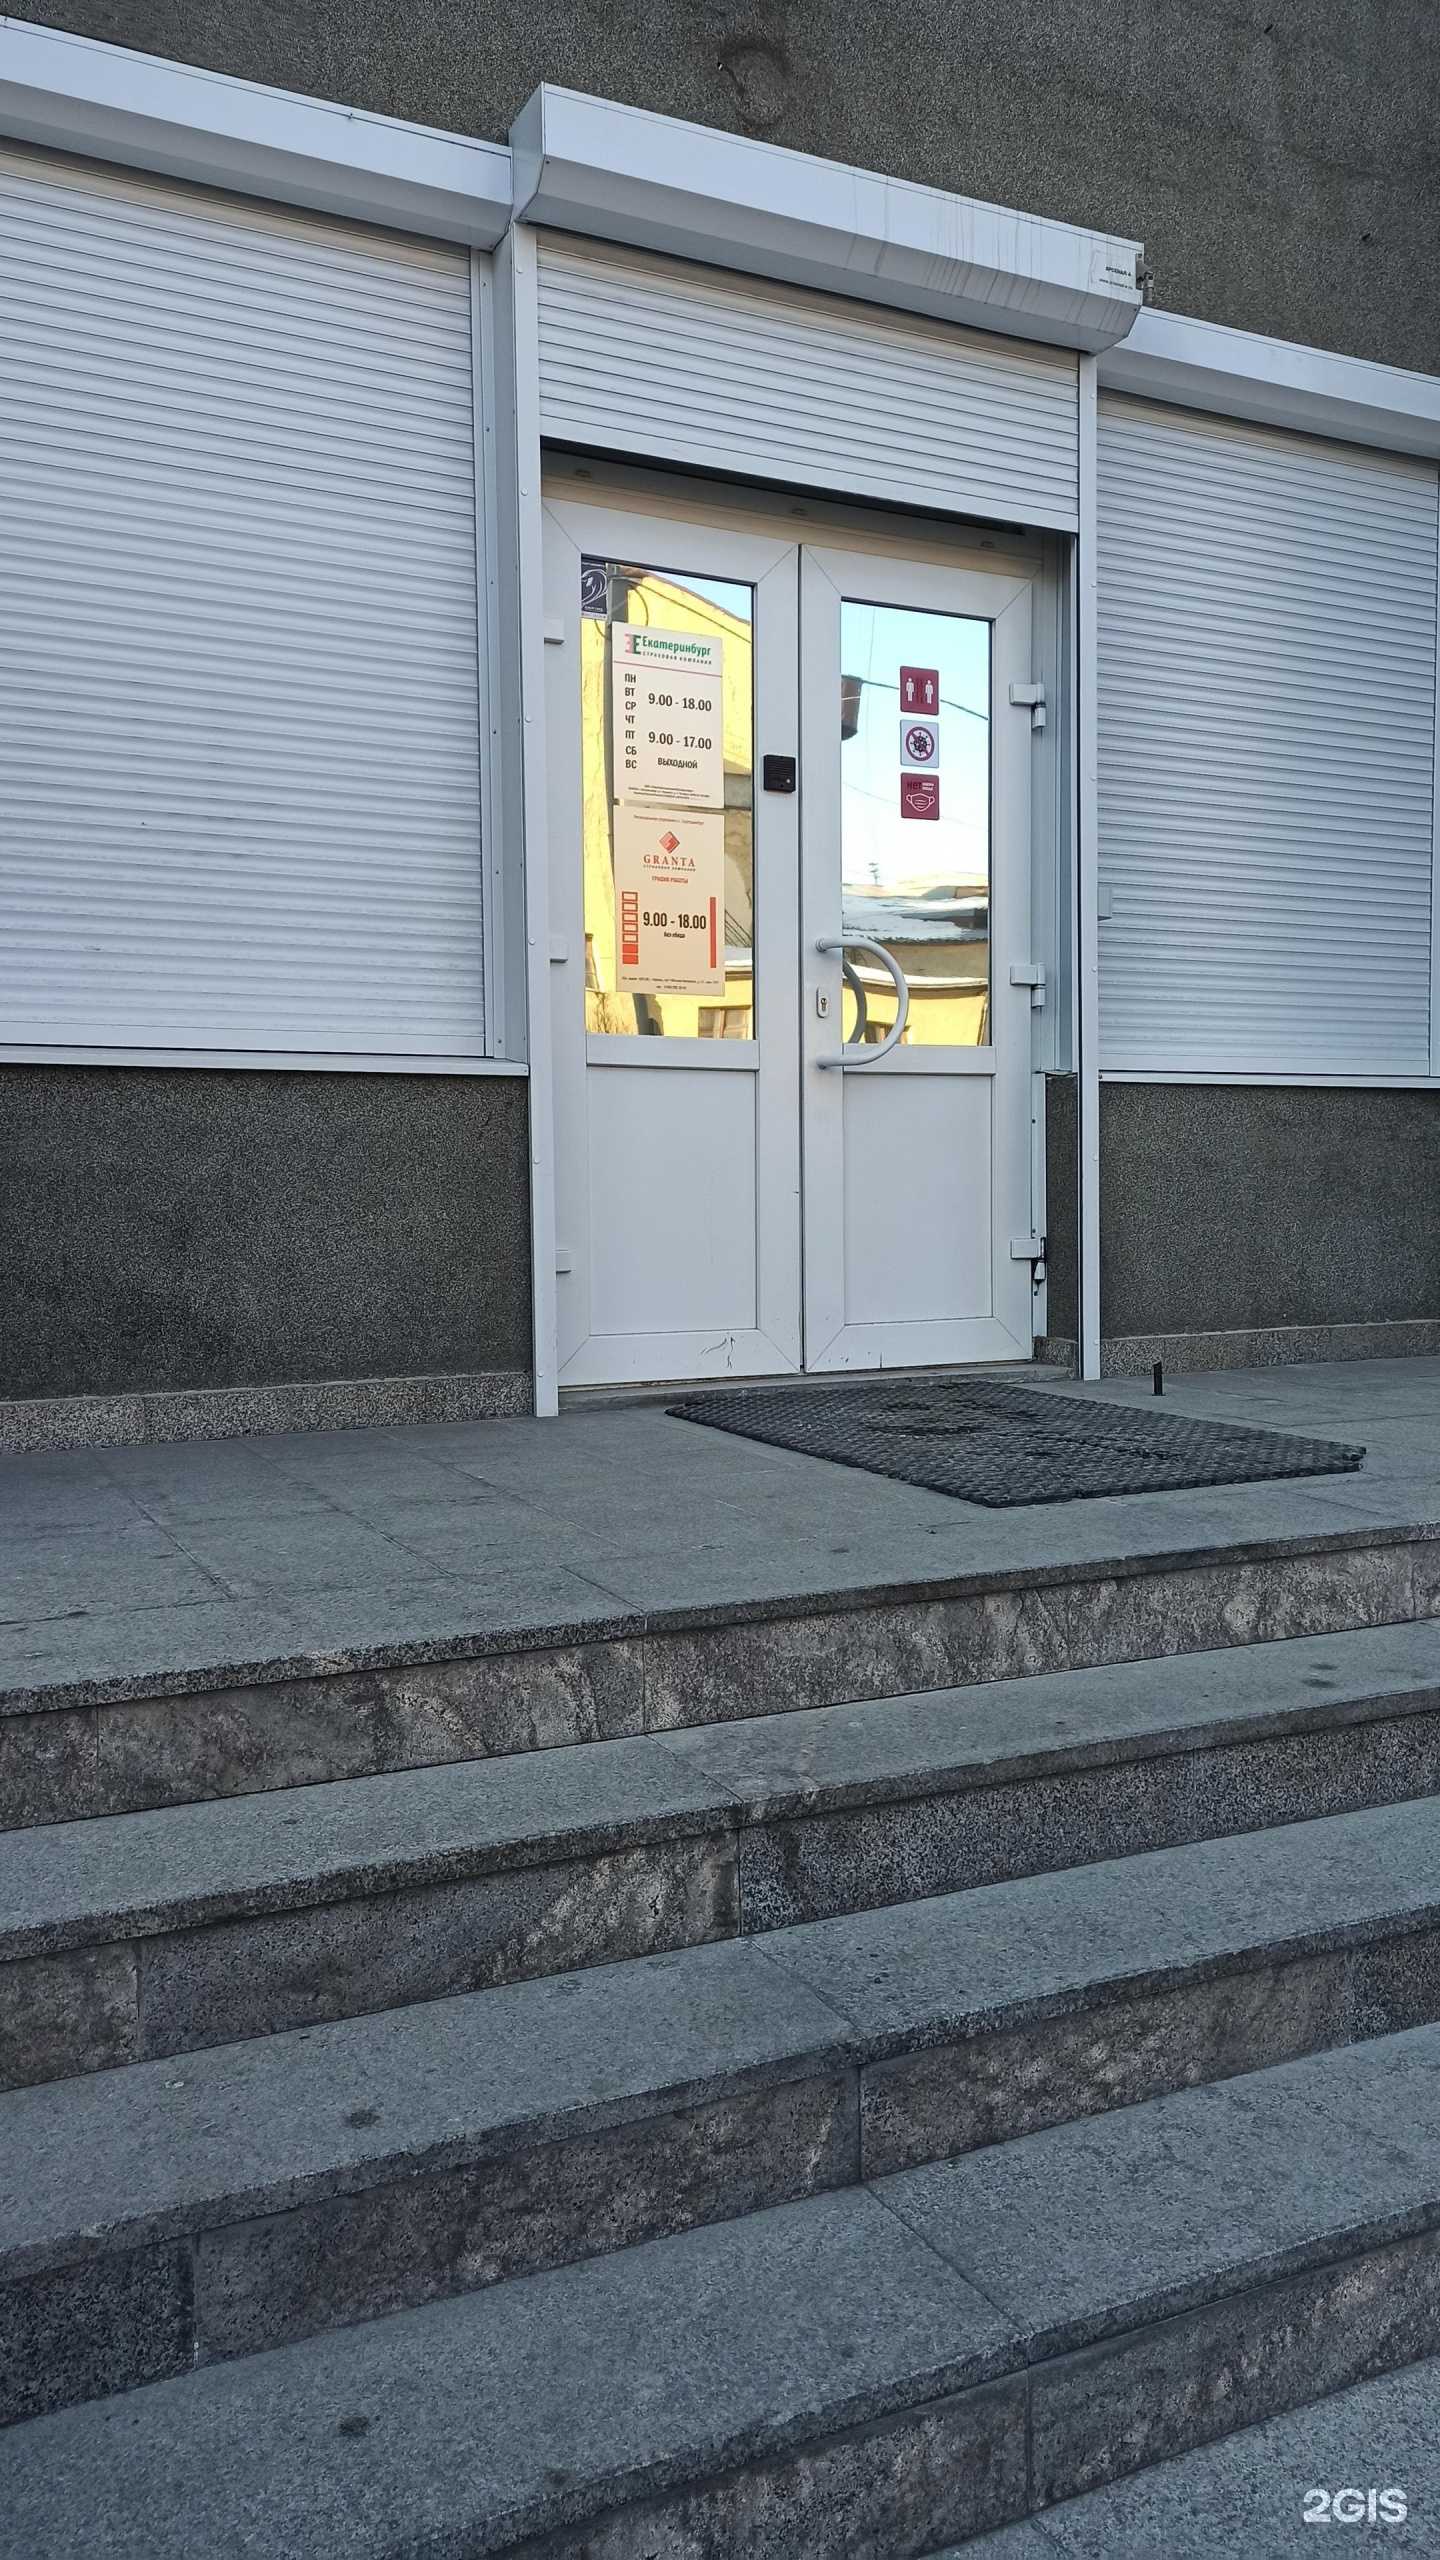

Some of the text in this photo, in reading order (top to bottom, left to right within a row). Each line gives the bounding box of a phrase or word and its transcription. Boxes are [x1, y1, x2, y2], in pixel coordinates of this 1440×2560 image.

[642, 635, 712, 657] Екатеринбург
[624, 673, 637, 683] ПН
[624, 687, 636, 697] ВТ
[625, 701, 637, 711] СР
[648, 692, 673, 707] 9.00
[682, 697, 712, 712] 18.00
[625, 715, 636, 724] ЧТ
[625, 730, 636, 740] ПТ
[648, 731, 674, 746] 9.00
[683, 735, 712, 750] 17.00
[625, 745, 637, 755] СБ
[625, 759, 637, 769] ВС
[643, 854, 695, 868] GRANTA
[643, 911, 668, 927] 9.00
[678, 914, 707, 929] 18.00
